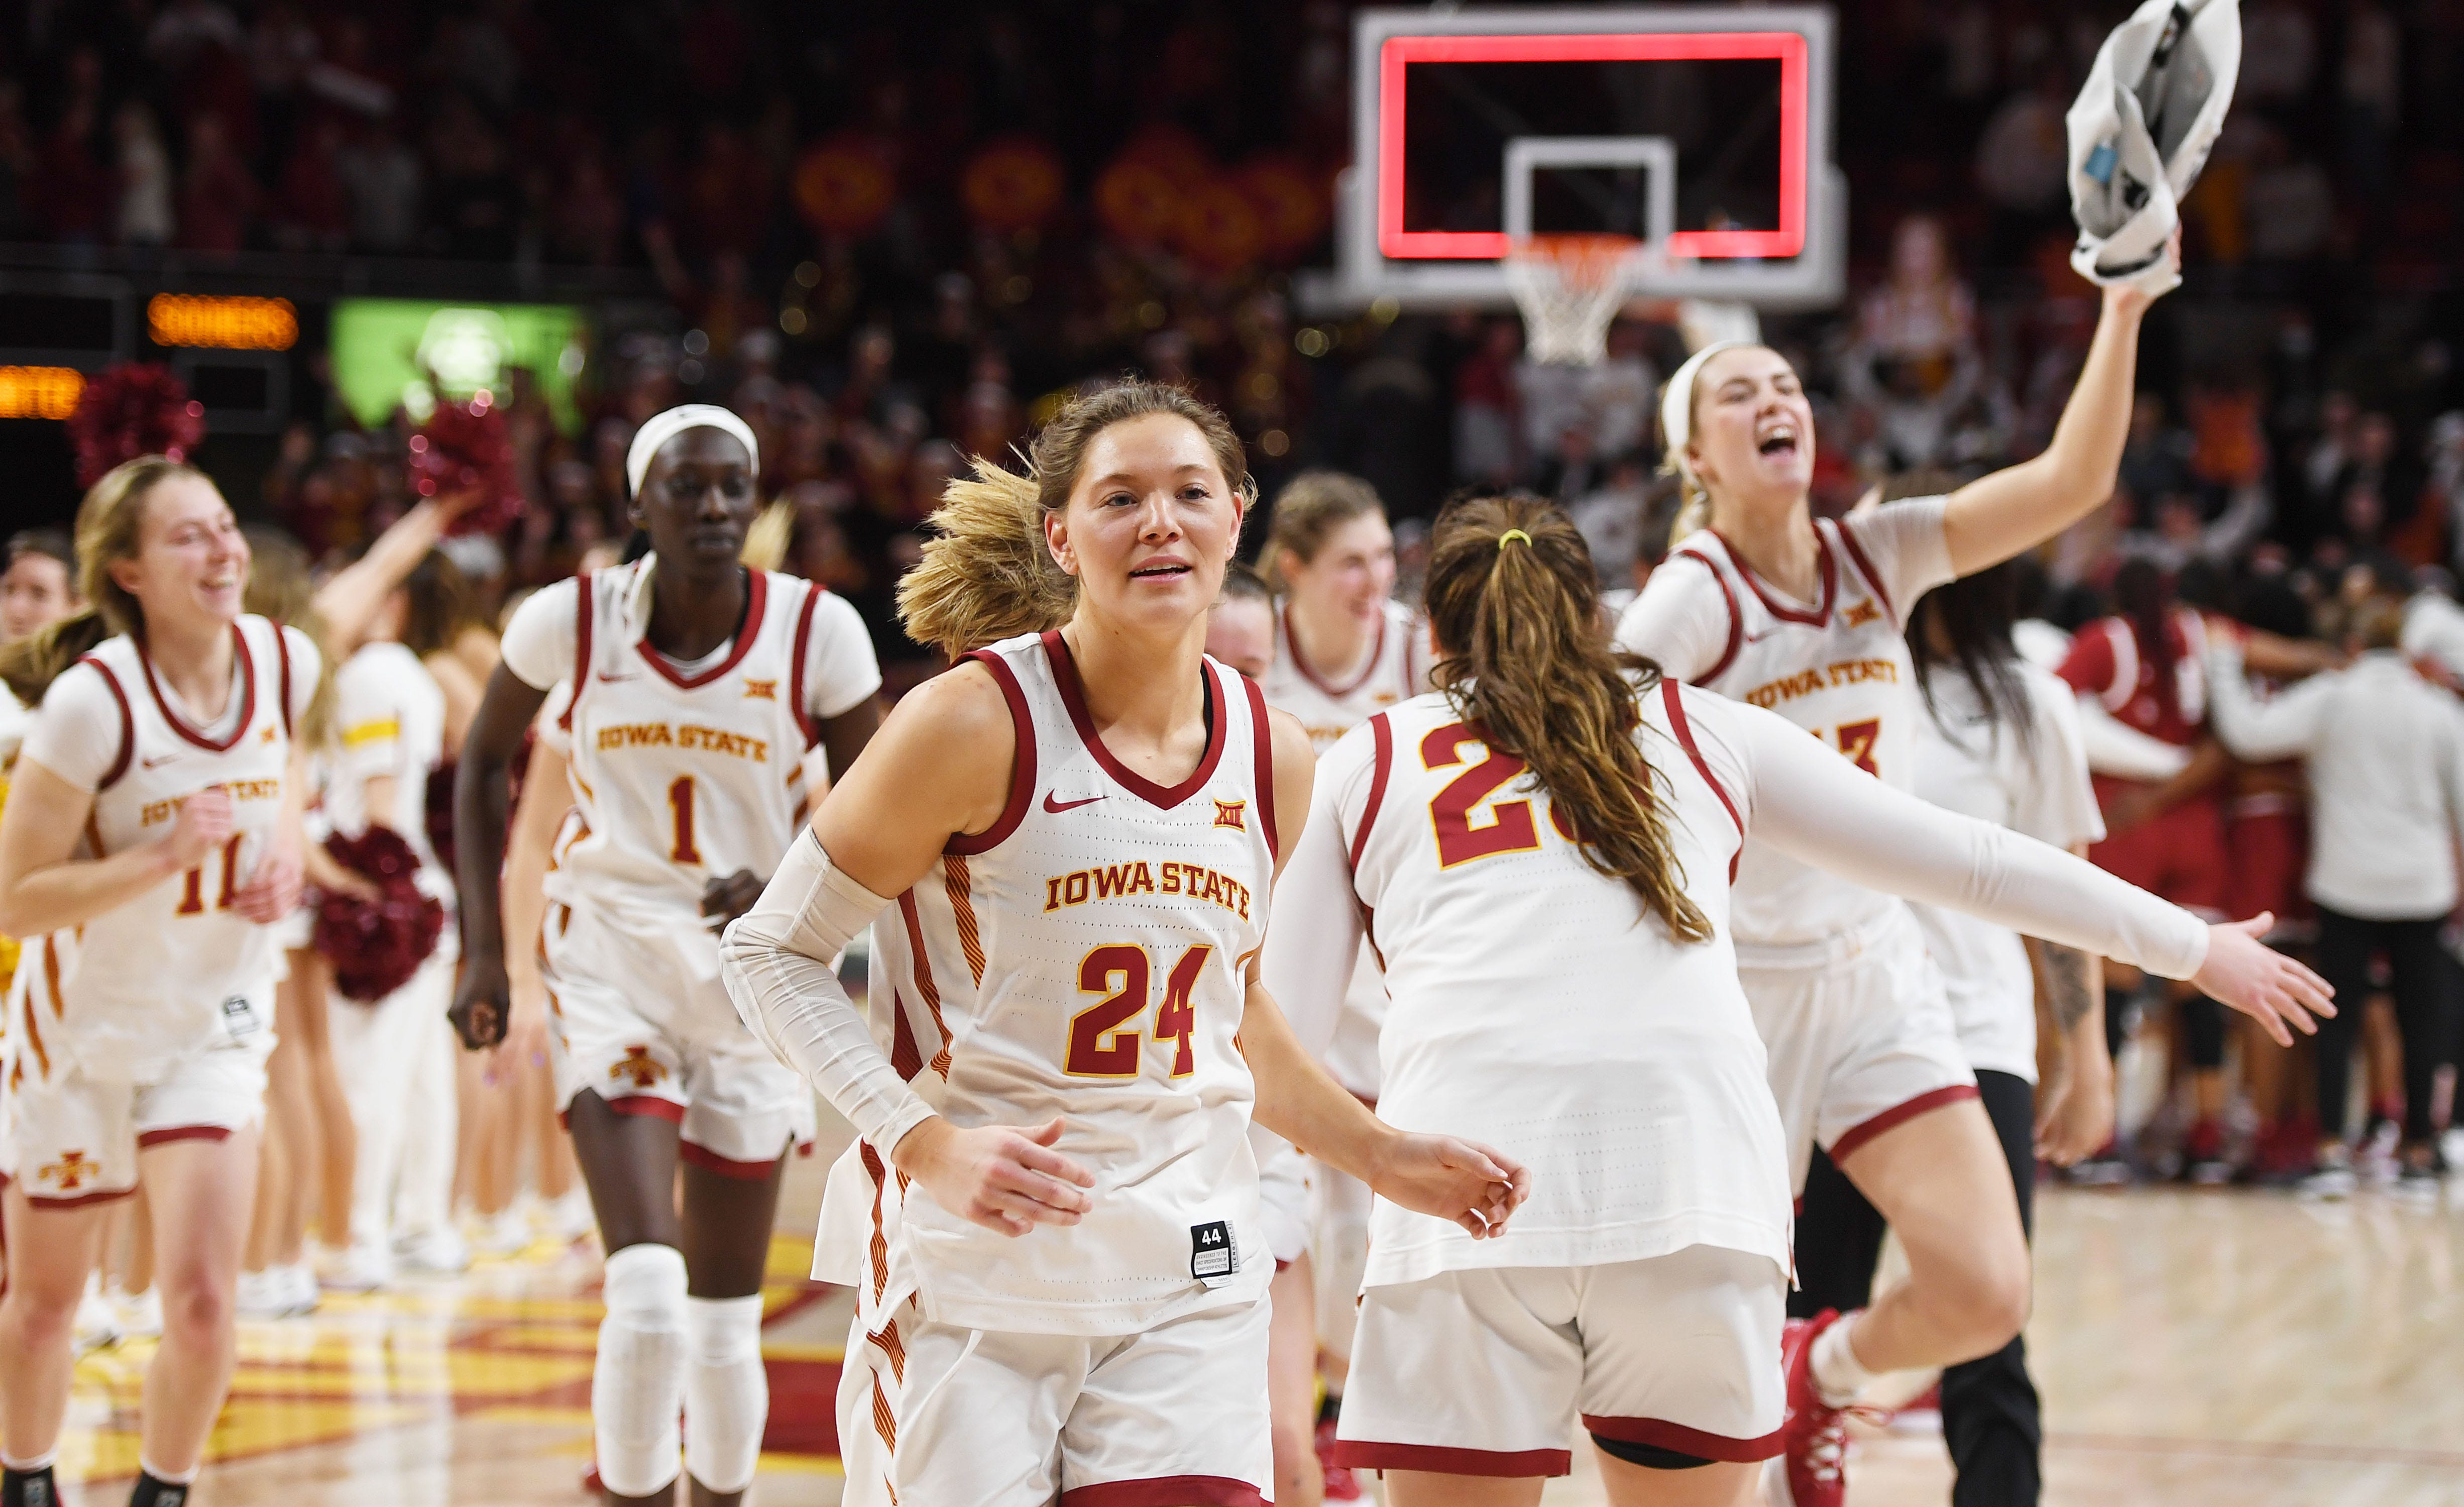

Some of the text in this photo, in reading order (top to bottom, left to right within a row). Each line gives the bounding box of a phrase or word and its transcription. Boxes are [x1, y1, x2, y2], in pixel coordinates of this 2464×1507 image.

[597, 722, 767, 762] IOWA STATE
[668, 774, 702, 865] 1
[1213, 798, 1246, 833] XII
[1043, 860, 1250, 924] IOWA STATE
[1063, 943, 1213, 1080] 24
[1202, 1228, 1221, 1245] 44
